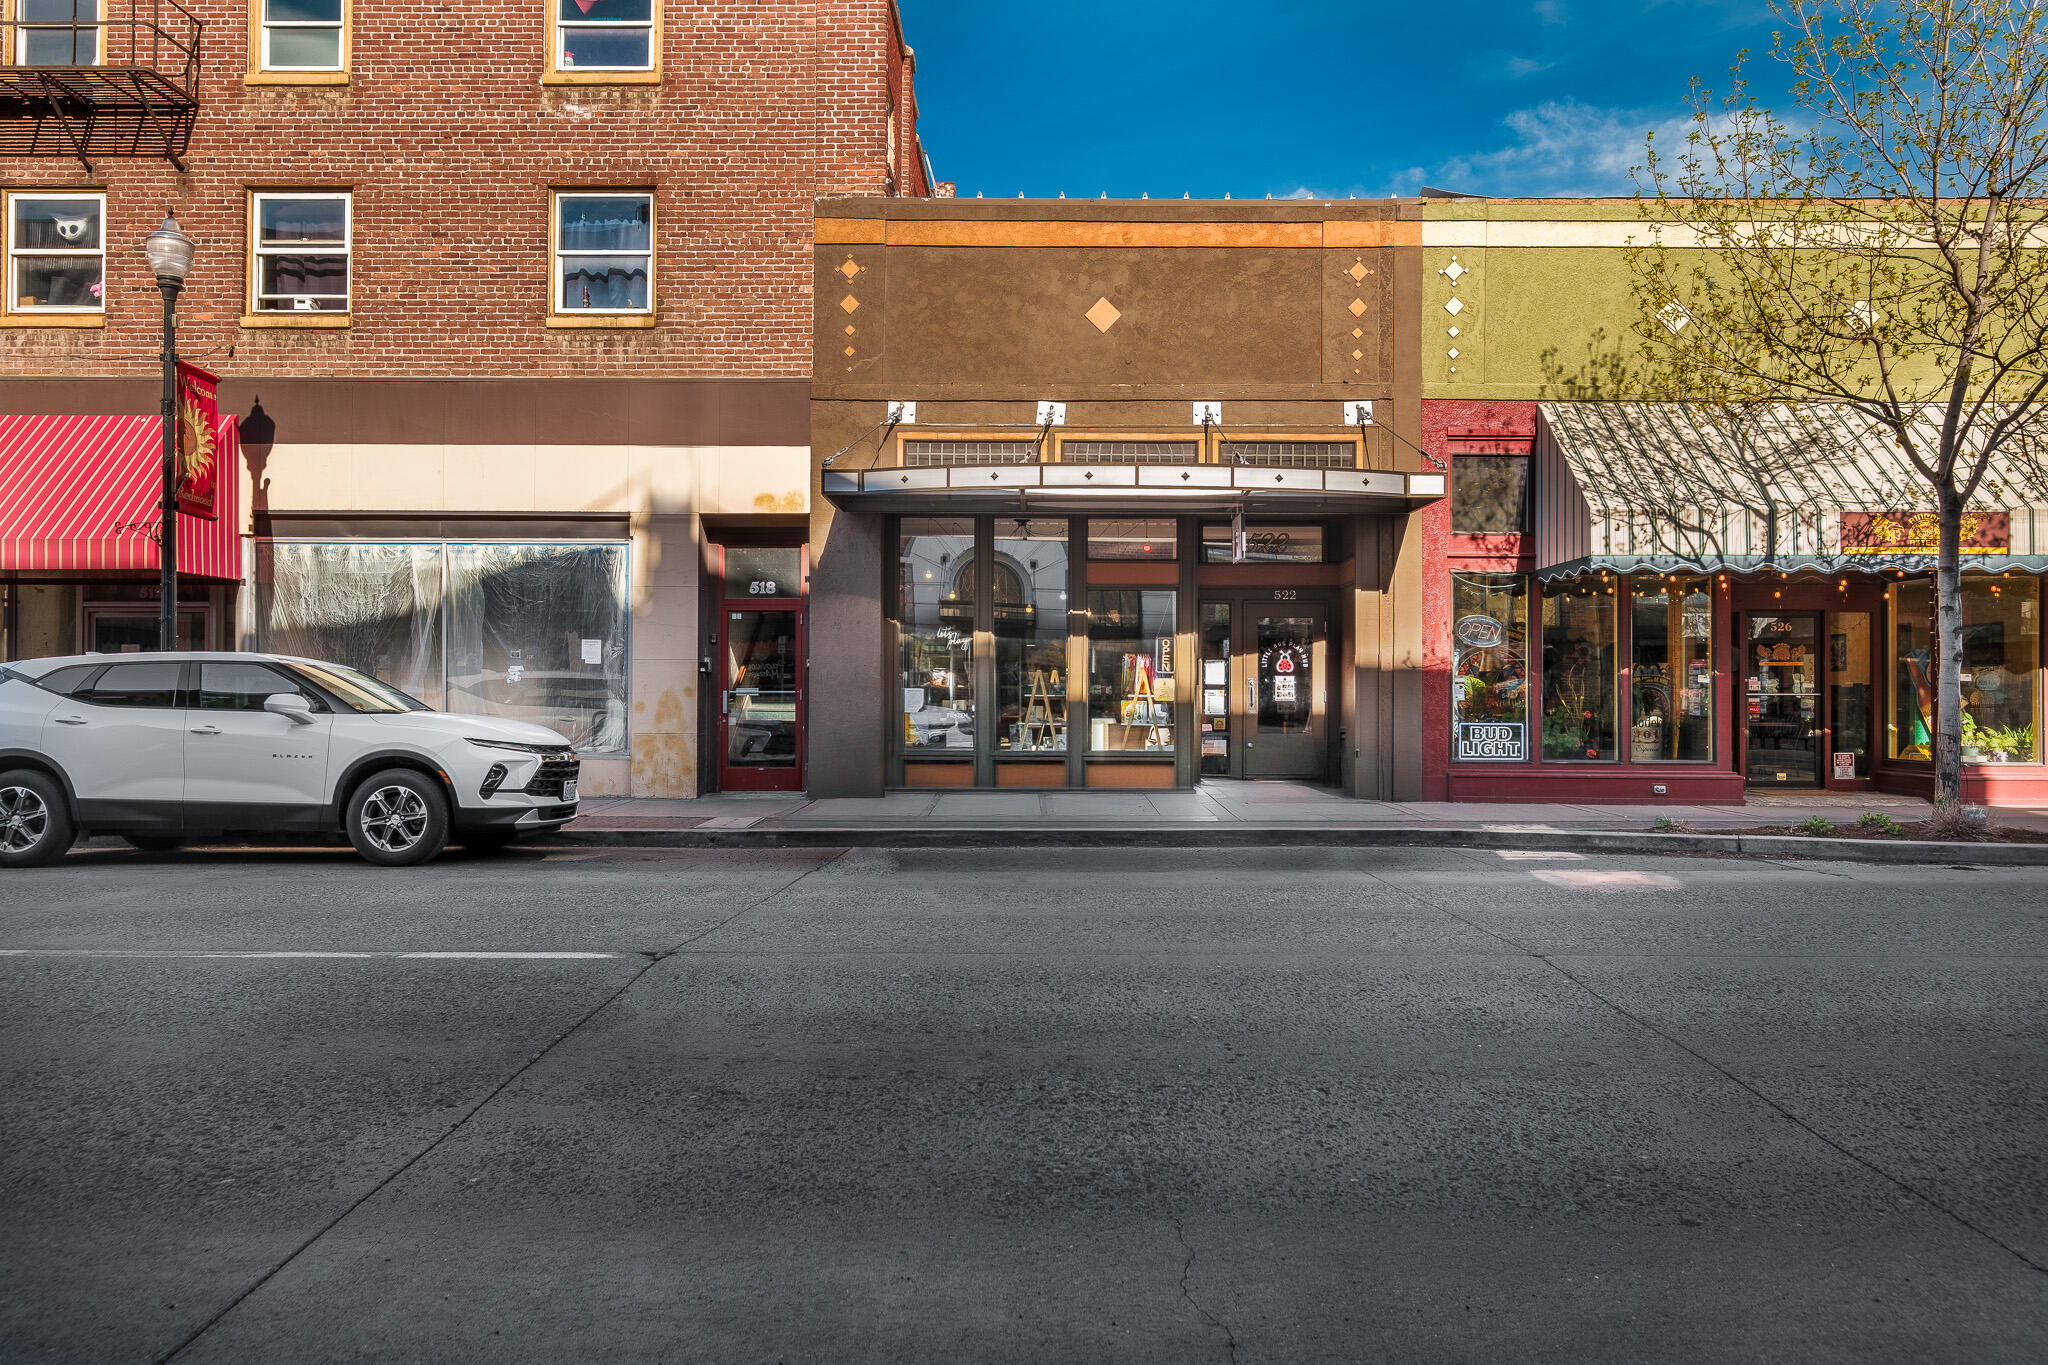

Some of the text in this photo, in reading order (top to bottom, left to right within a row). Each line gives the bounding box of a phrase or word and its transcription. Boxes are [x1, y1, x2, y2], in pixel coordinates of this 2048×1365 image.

[749, 581, 776, 595] 518
[1274, 590, 1297, 600] 522
[1458, 622, 1502, 641] OPEN
[1770, 622, 1792, 632] 526
[946, 631, 974, 651] play
[1162, 639, 1171, 672] OPEN
[1261, 648, 1272, 668] LITTLE
[1289, 641, 1303, 653] PLAY
[1470, 726, 1512, 741] BUD
